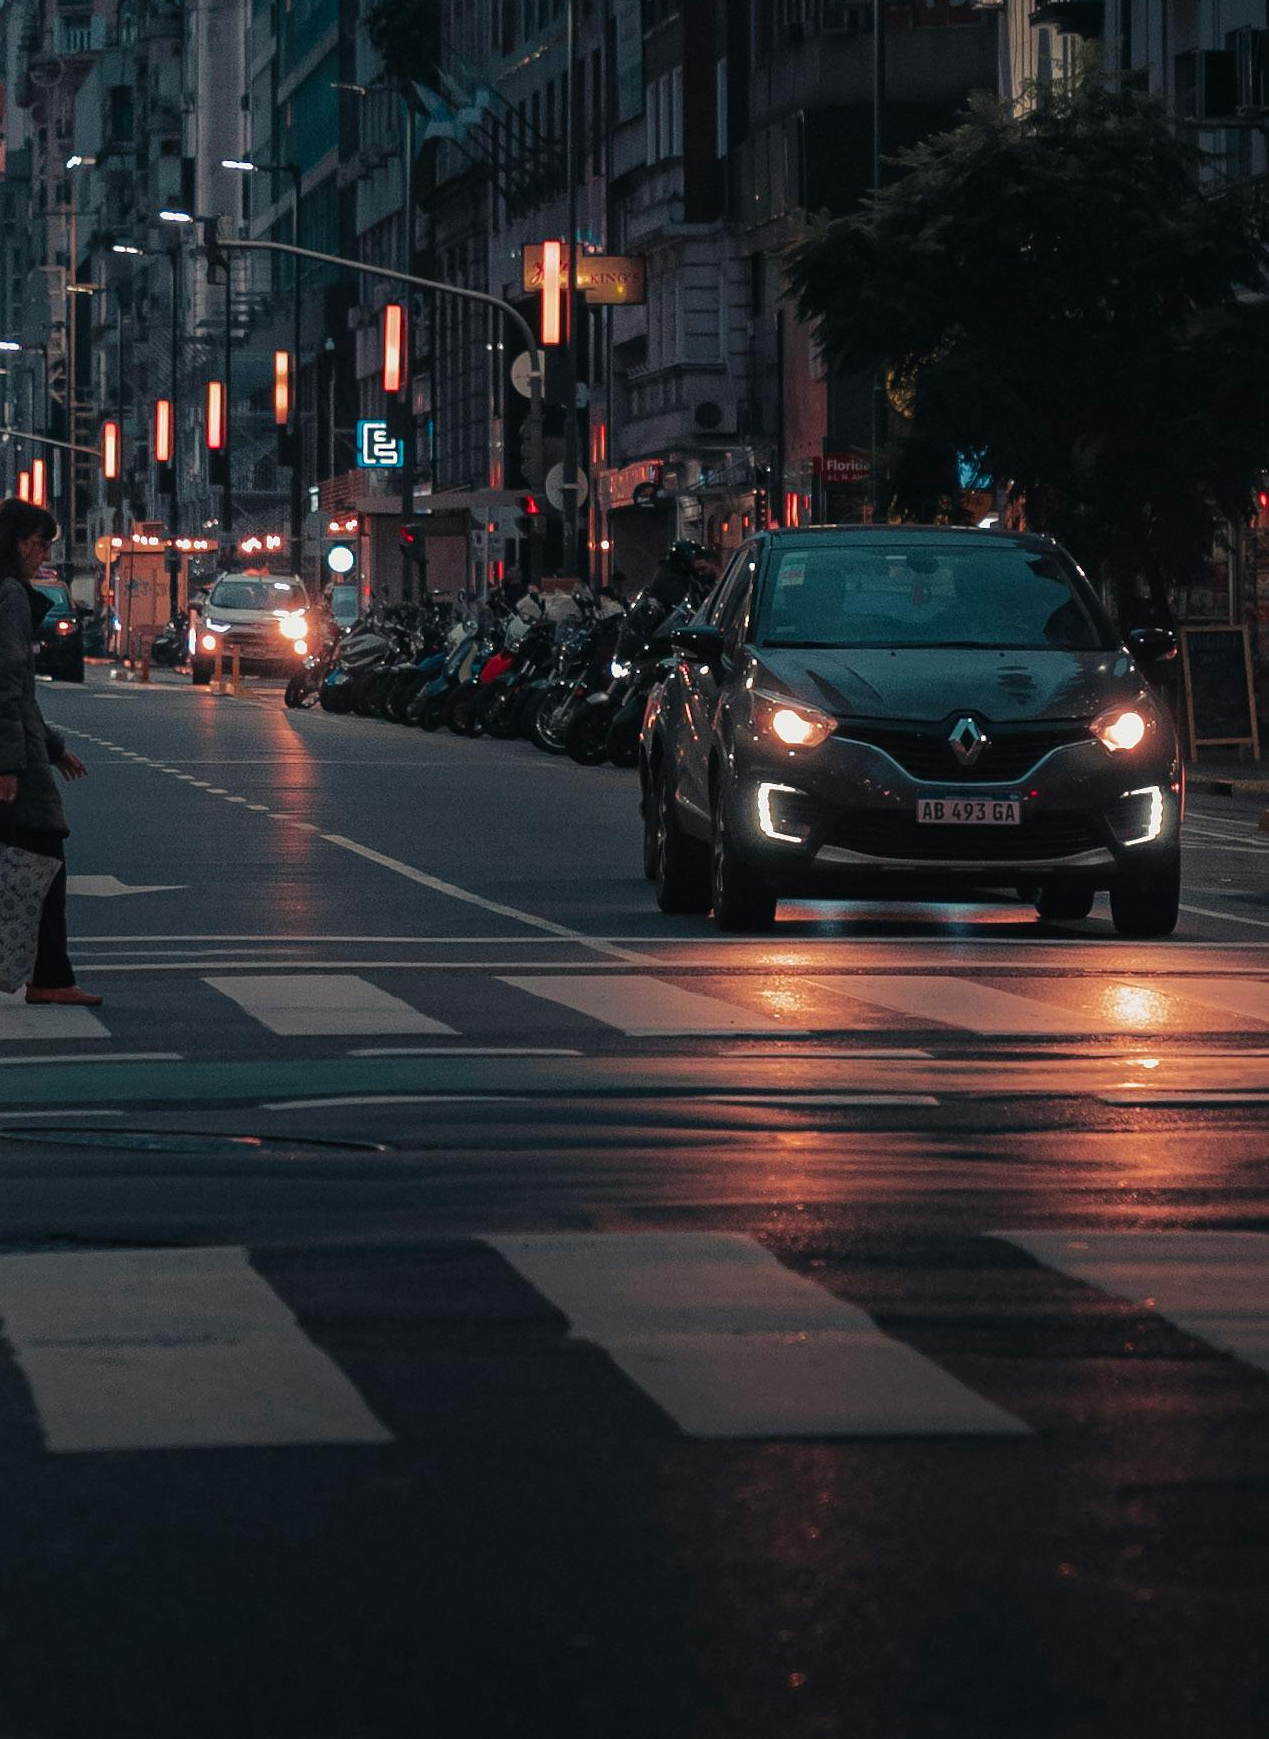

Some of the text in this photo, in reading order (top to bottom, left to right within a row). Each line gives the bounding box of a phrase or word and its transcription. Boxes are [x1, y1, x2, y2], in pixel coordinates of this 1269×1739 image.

[590, 271, 640, 285] KING'S
[923, 802, 1015, 822] AB 493 GA
